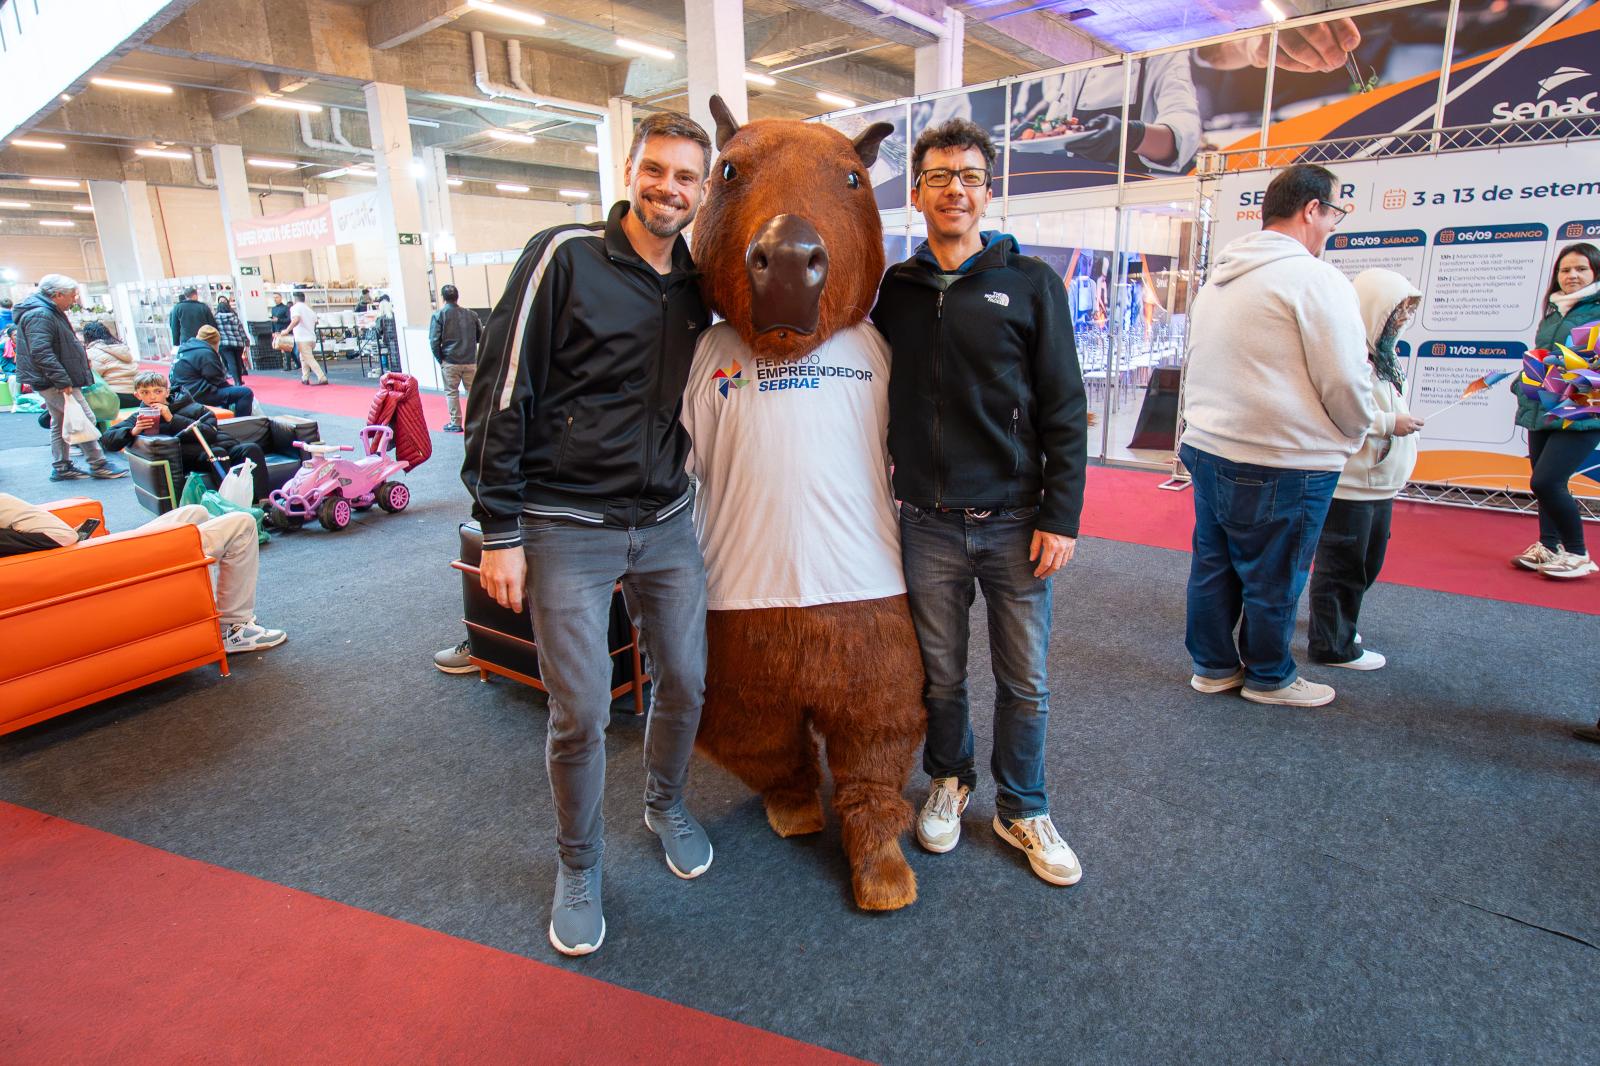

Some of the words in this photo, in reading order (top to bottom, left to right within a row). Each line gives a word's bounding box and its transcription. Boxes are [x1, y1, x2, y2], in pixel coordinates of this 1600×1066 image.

[1490, 91, 1598, 123] senac
[1412, 191, 1426, 206] 3
[1432, 193, 1445, 204] a
[1453, 187, 1475, 203] 13
[1482, 185, 1513, 201] de
[1350, 236, 1380, 246] 05/09
[1457, 230, 1492, 242] 06/09
[1494, 230, 1543, 239] DOMINGO
[1449, 345, 1477, 356] 11/09
[1478, 348, 1507, 356] SEXTA
[800, 354, 820, 365] DO
[756, 364, 873, 382] EMPREENDEDOR
[758, 377, 820, 392] SEBRAE
